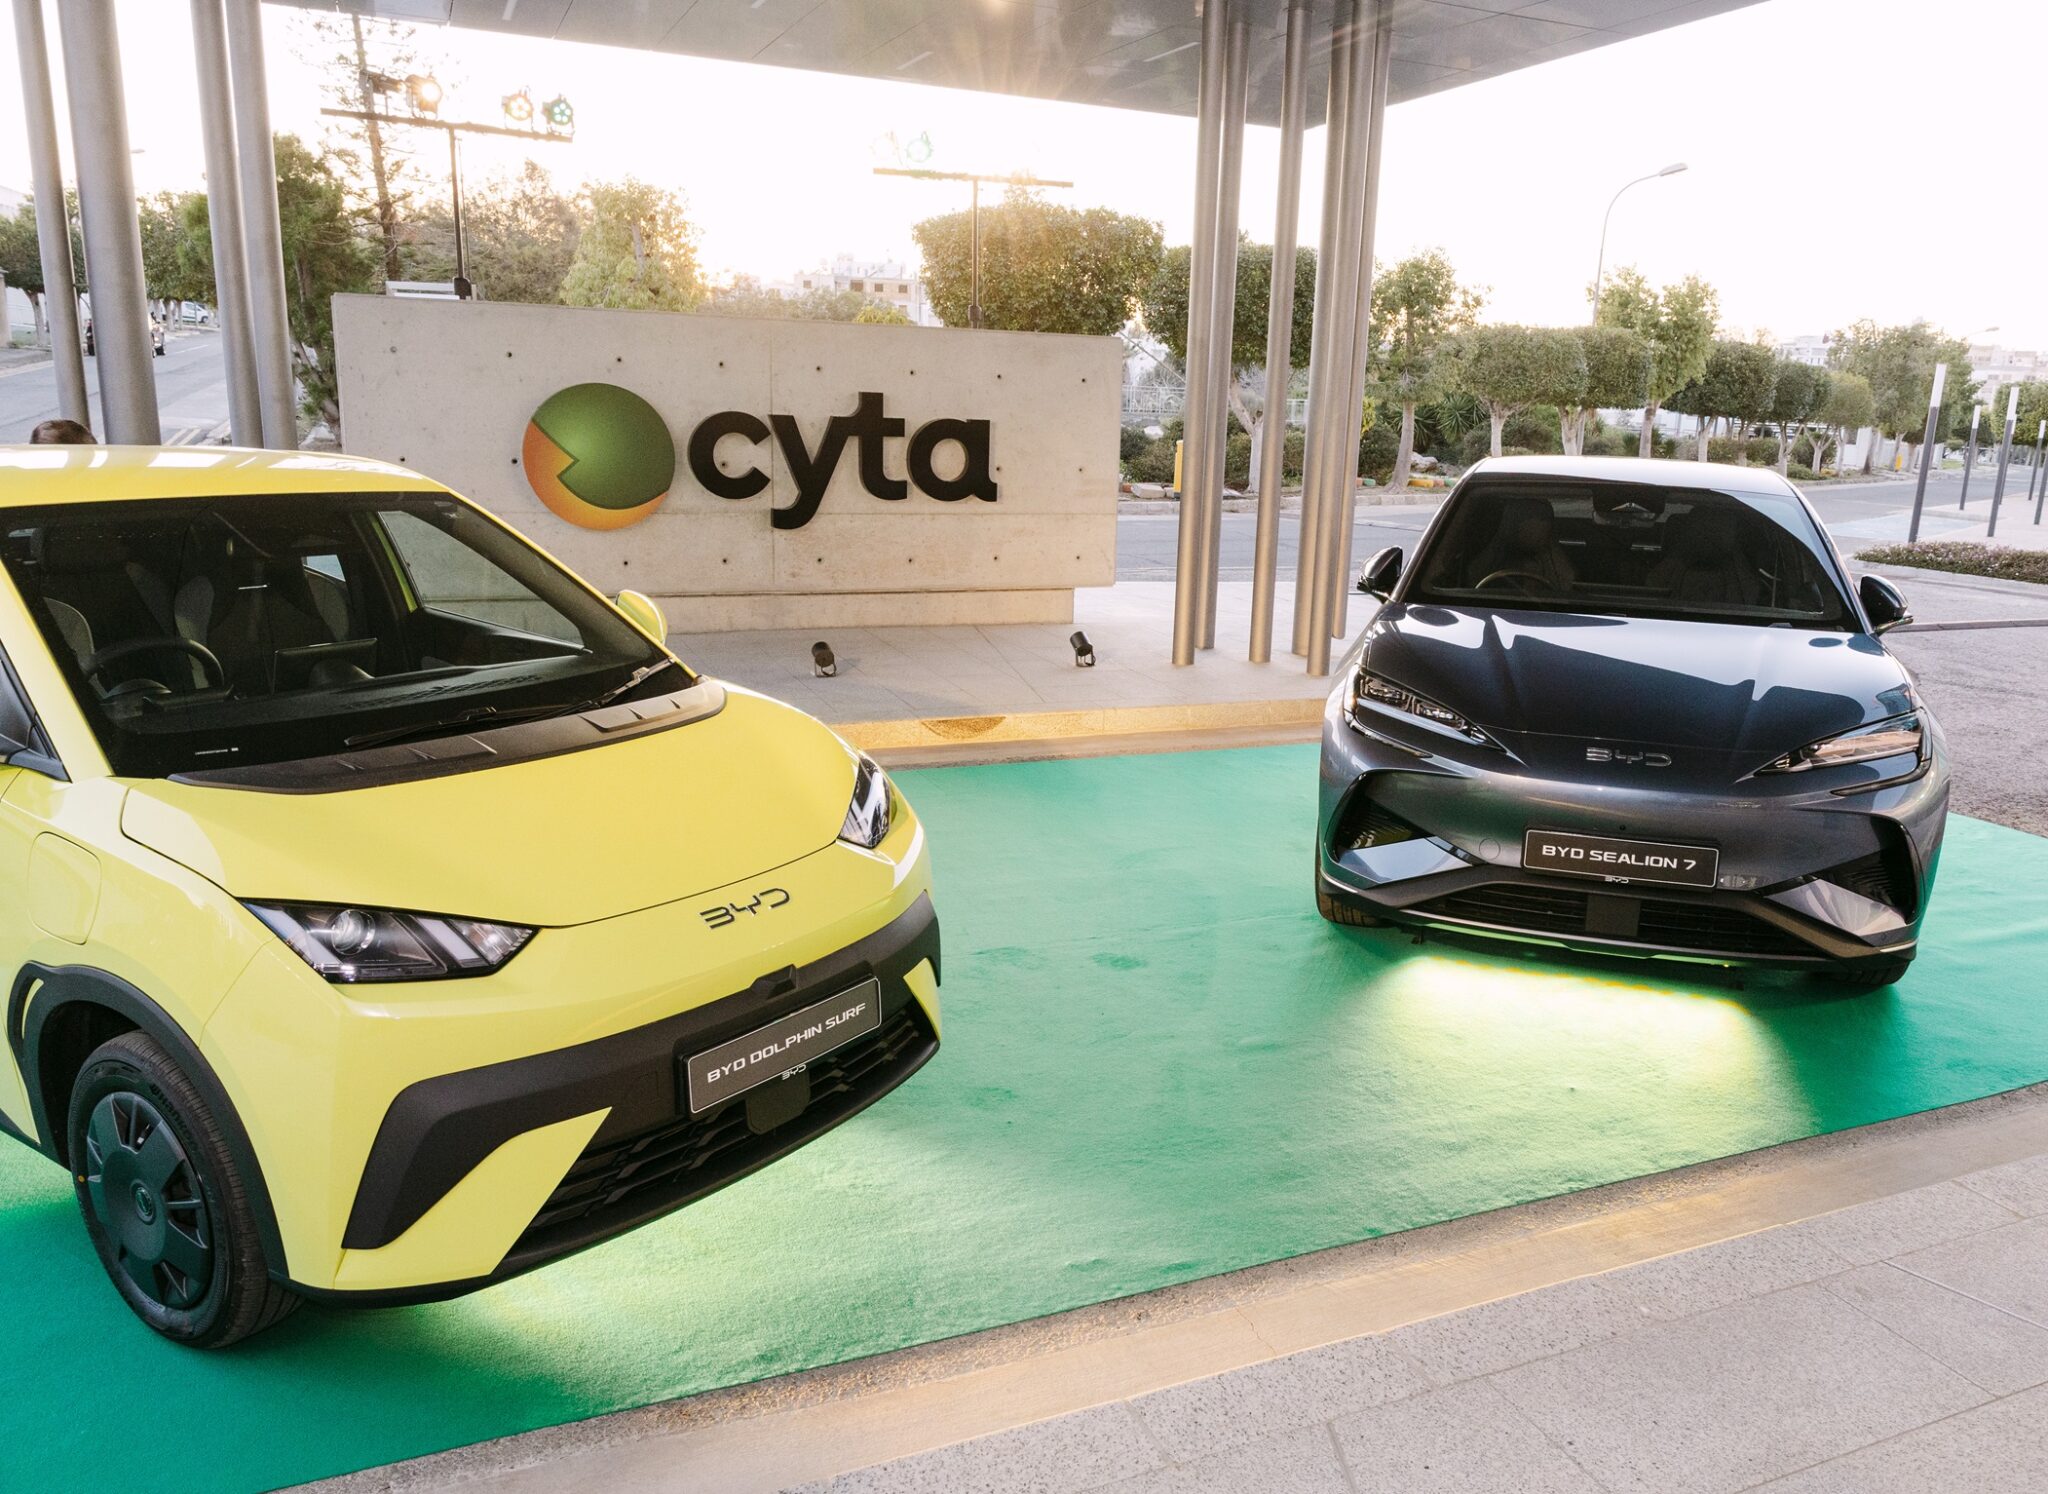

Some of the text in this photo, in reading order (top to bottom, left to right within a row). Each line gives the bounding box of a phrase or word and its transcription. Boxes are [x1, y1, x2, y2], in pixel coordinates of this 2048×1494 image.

[688, 391, 998, 530] cyta
[1586, 747, 1672, 767] BYD
[1541, 844, 1697, 871] BYD SEALION 7
[700, 887, 790, 929] BYD
[707, 1002, 867, 1084] BYD DOLPHIN SURF
[782, 1062, 807, 1081] BYD
